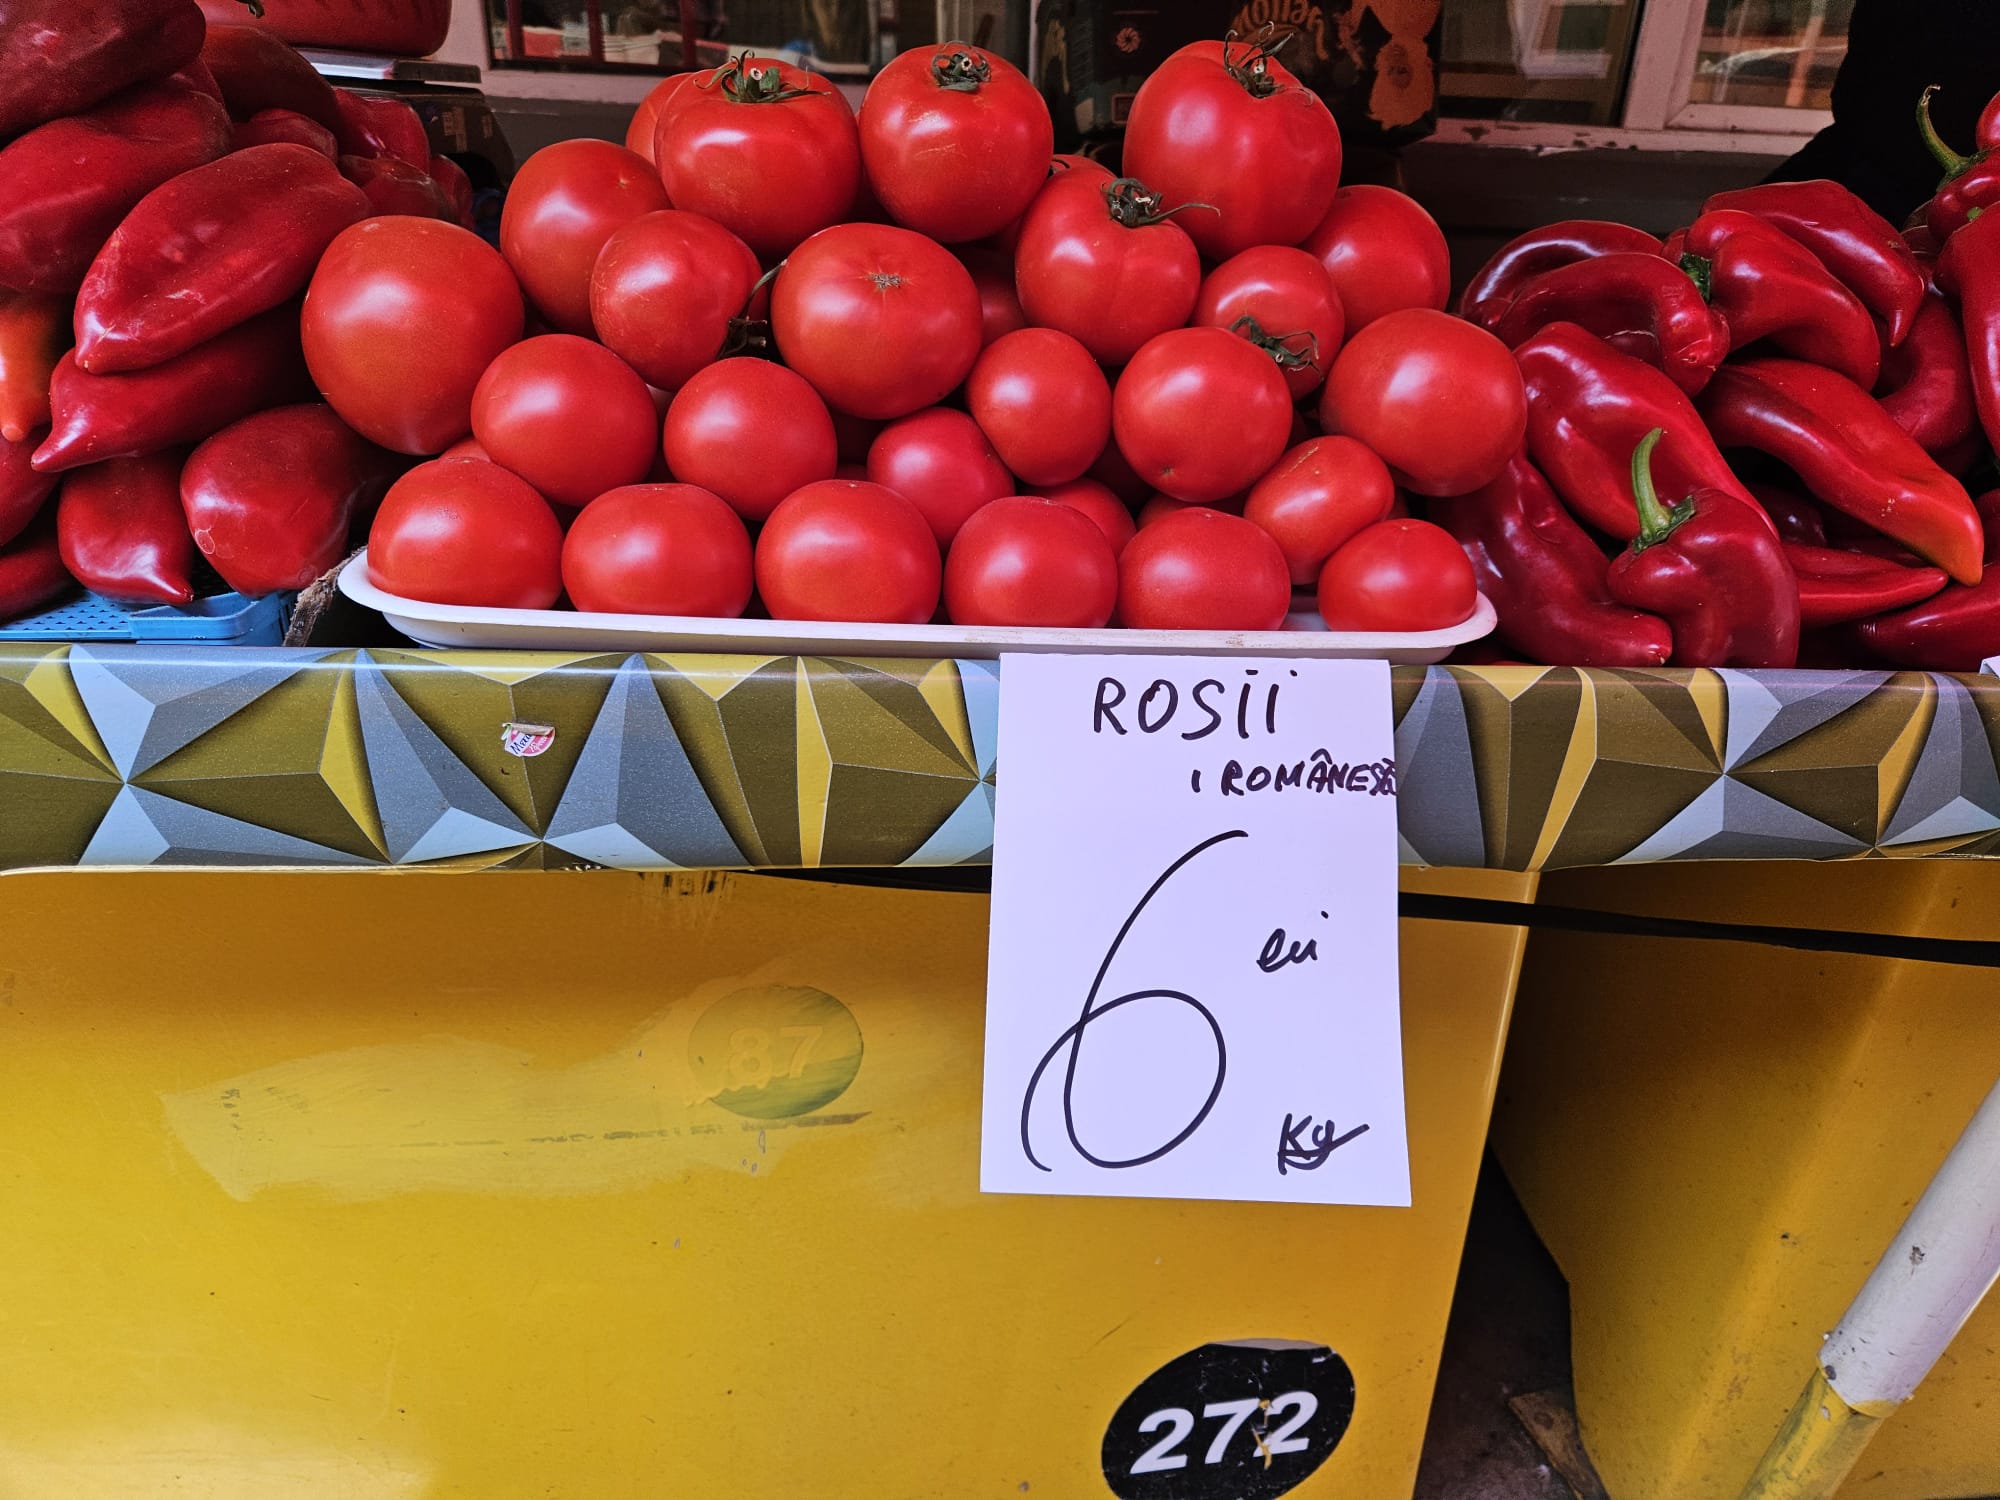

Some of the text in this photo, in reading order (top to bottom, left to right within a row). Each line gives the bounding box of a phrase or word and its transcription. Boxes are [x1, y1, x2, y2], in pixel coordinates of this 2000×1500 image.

[1021, 829, 1249, 1172] 6
[729, 1024, 824, 1084] 87
[1129, 1390, 1319, 1475] 272
